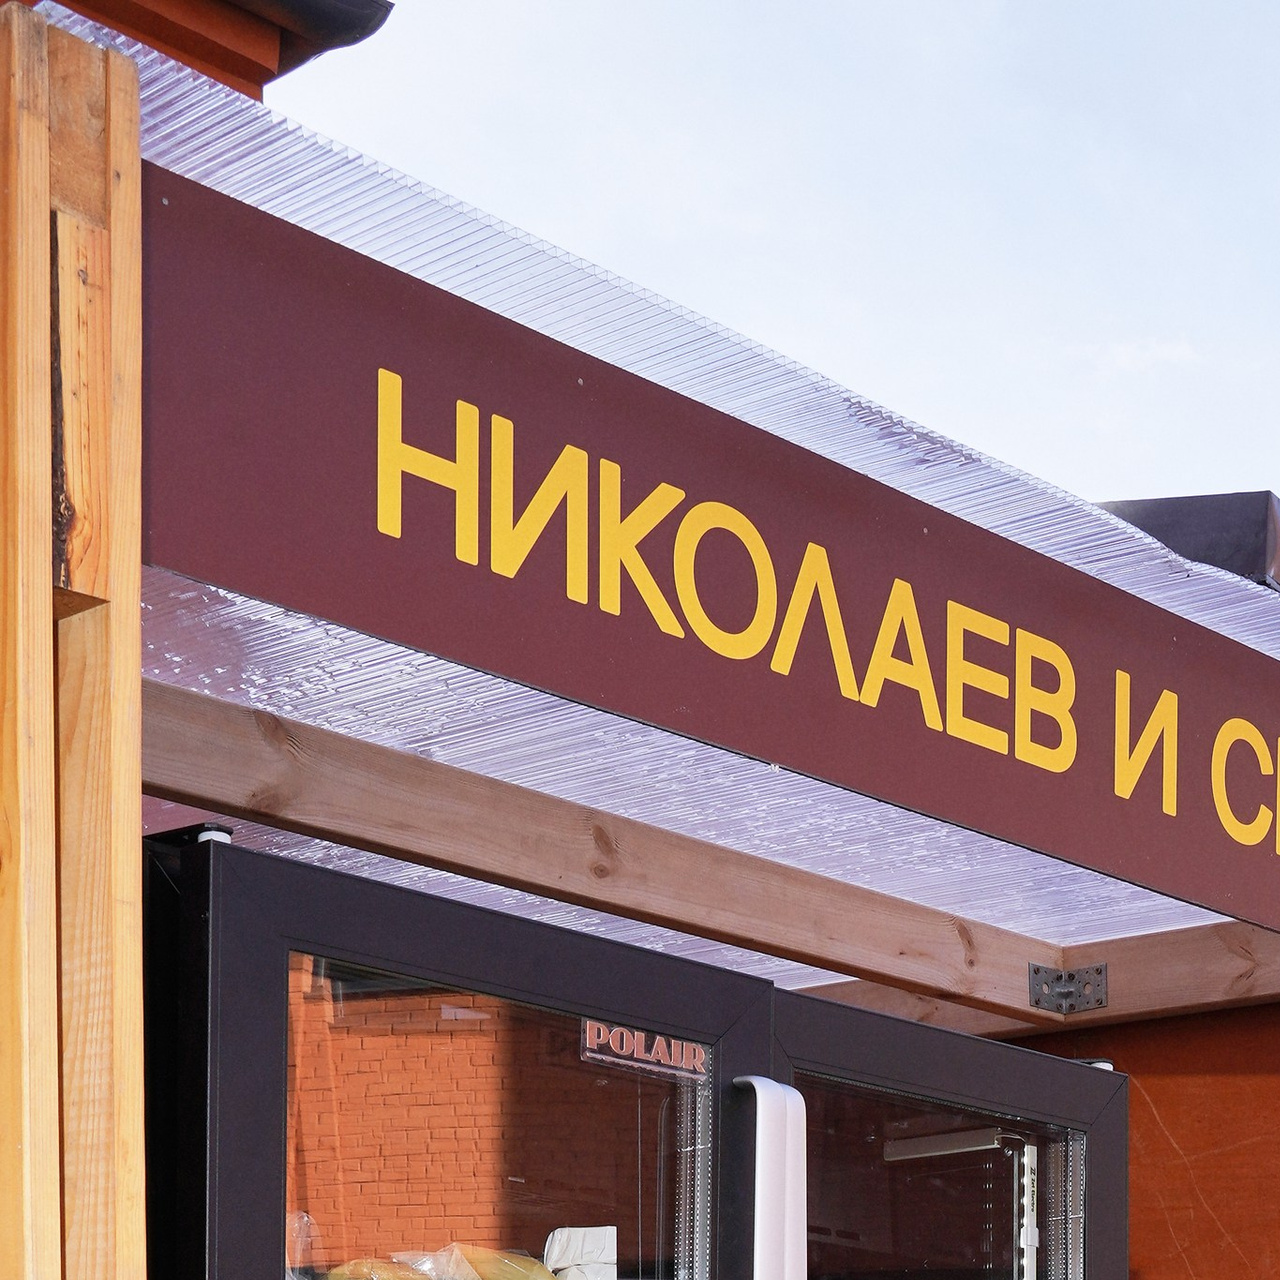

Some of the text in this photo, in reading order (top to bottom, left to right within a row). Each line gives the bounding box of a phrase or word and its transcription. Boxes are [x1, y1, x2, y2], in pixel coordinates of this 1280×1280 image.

[377, 367, 1078, 774] НИКОЛАЕВ
[1113, 669, 1179, 817] И
[586, 1020, 706, 1073] POLAIR
